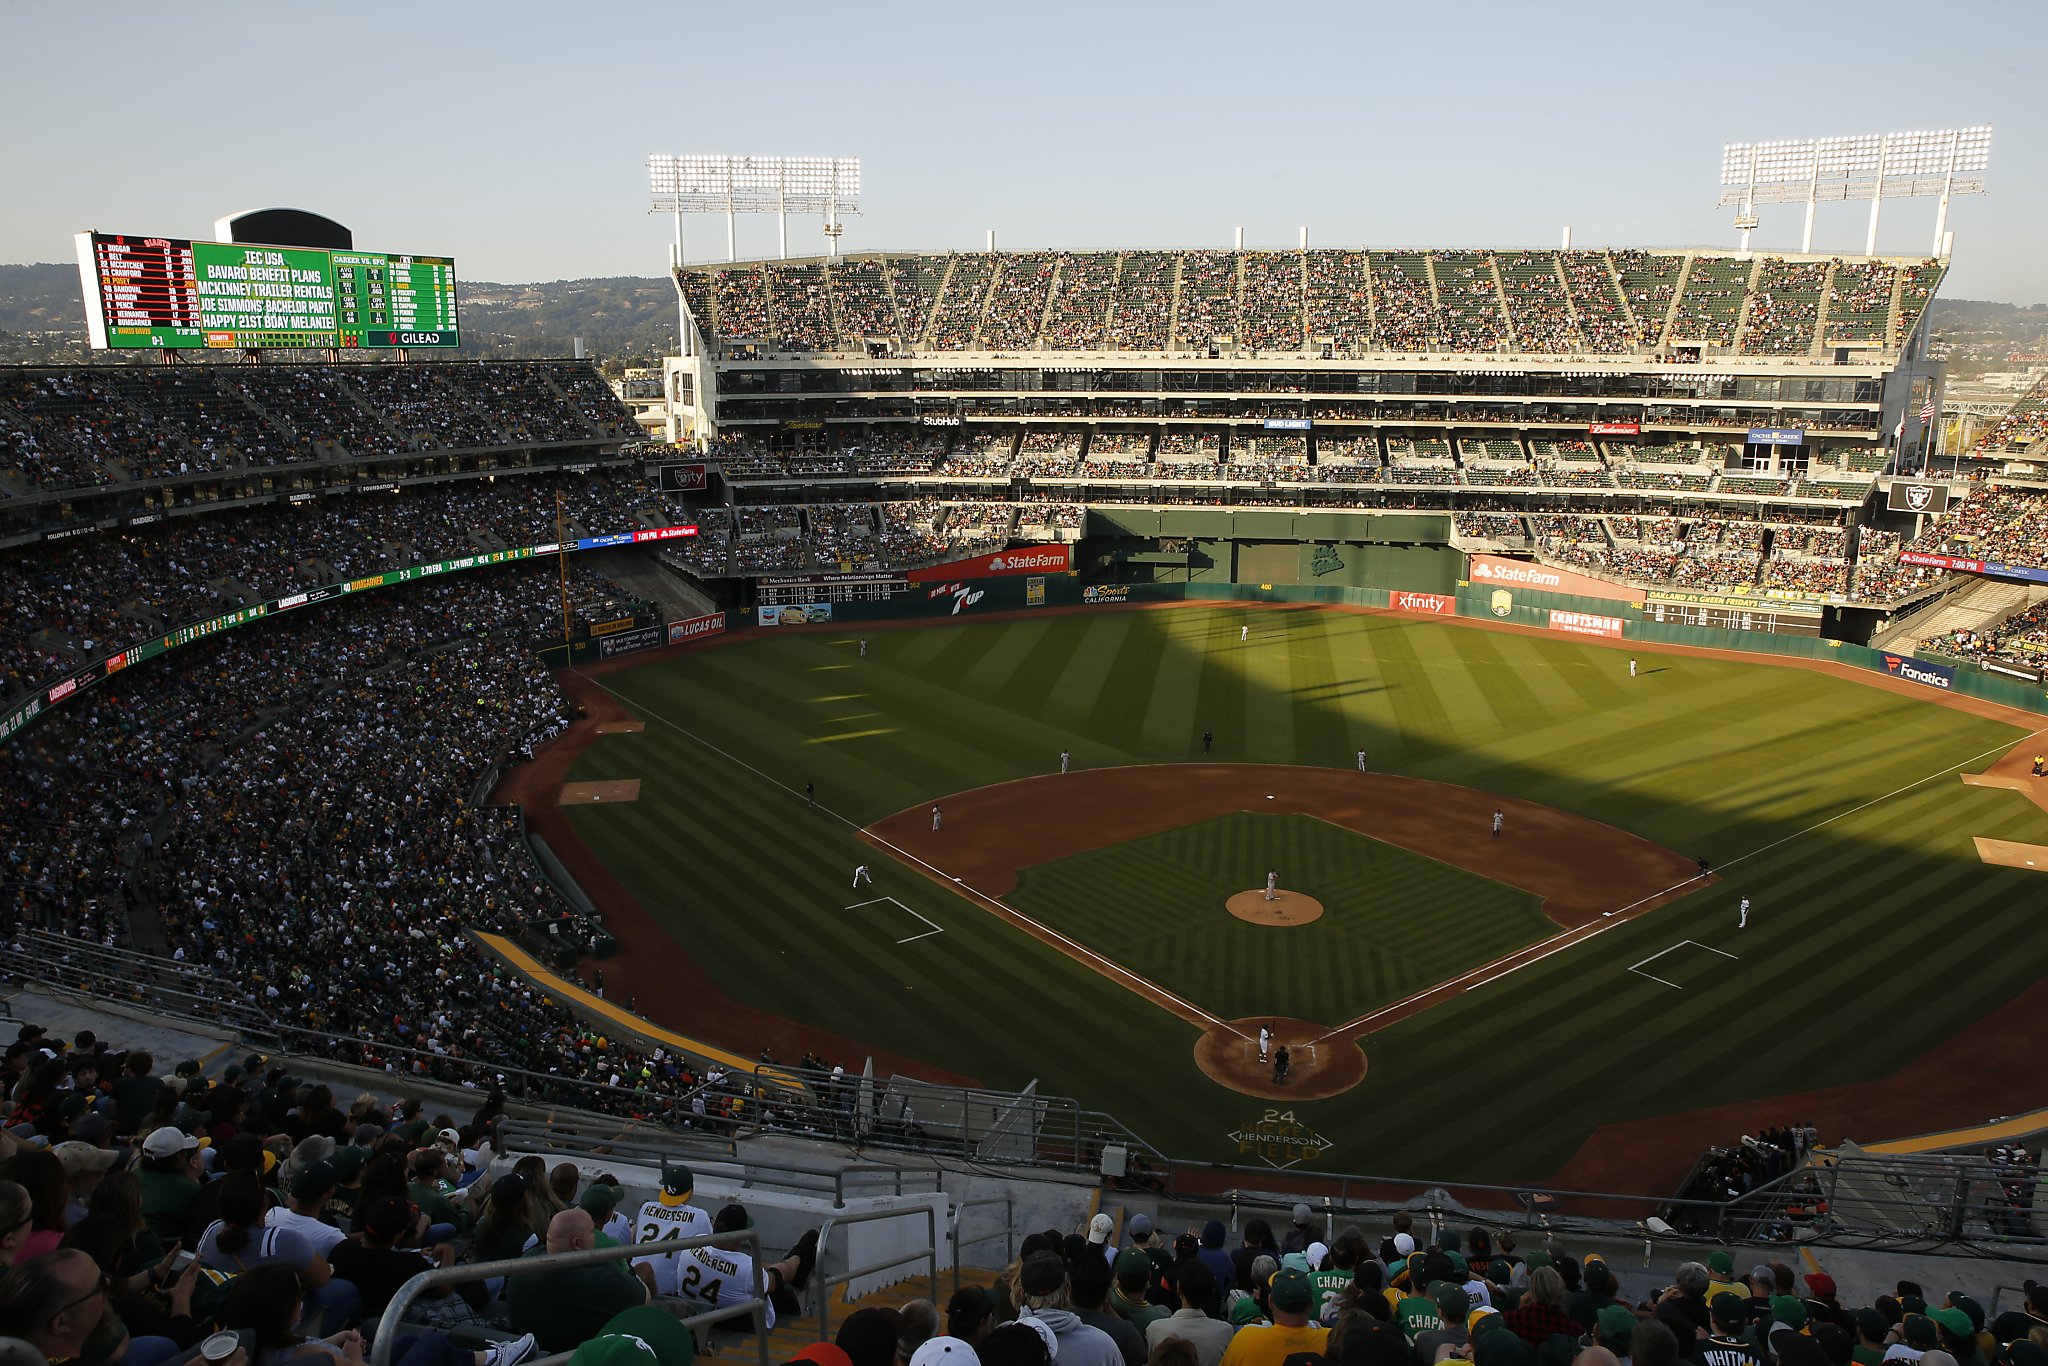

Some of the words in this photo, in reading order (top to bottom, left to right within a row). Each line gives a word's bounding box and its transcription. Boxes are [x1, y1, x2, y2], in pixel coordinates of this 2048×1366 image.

[107, 244, 131, 253] DUGGAR
[144, 238, 171, 248] GIANTS
[110, 261, 144, 269] MCCUTCHEN
[244, 250, 263, 265] IEC
[264, 251, 284, 266] USA
[334, 256, 360, 264] CAREER
[111, 269, 142, 277] CRAWFORD
[207, 265, 247, 280] BAVARO
[249, 267, 290, 282] BENEFIT
[291, 270, 321, 283] PLANS
[112, 277, 130, 285] POSEY
[198, 280, 251, 296] MCKINNEY
[253, 283, 293, 298] TRAILER
[294, 285, 333, 299] RENTALS
[200, 297, 217, 312] JOE
[219, 298, 264, 313] SIMMONS'
[265, 300, 308, 314] BACHELOR
[308, 301, 334, 315] PARTY
[202, 314, 236, 329] HAPPY
[239, 315, 263, 329] 21ST
[264, 315, 289, 329] BDAY
[291, 316, 335, 329] MELANIE!
[401, 333, 440, 344] GILEAD
[923, 417, 960, 426] StubHub
[1591, 424, 1638, 435] Budweiser
[363, 483, 394, 492] FOUNDATION
[47, 532, 64, 540] FOLLOW
[649, 531, 658, 539] PM
[668, 528, 695, 537] StateFarm
[351, 576, 384, 590] BUMGARNER
[421, 566, 432, 576] 2.70
[432, 564, 443, 573] ERA
[529, 548, 533, 556] T
[1006, 554, 1065, 569] StateFarm
[1910, 554, 1946, 566] StateFarm
[1952, 560, 1966, 569] 7:06
[1966, 562, 1978, 571] PM
[1492, 565, 1560, 587] StateFarm
[1097, 585, 1131, 598] Sports
[1649, 591, 1687, 601] OAKLAND
[1700, 596, 1725, 605] GREEN
[1725, 598, 1759, 607] FRIDAYS
[278, 593, 308, 609] LAGUNITAS
[1084, 596, 1127, 604] CALIFORNIA
[1398, 593, 1445, 613] xfinity
[1630, 601, 1643, 609] 362
[228, 614, 236, 624] SFG
[249, 608, 257, 617] OAK
[1551, 612, 1620, 631] CRAFTSMAN
[200, 624, 205, 635] S
[684, 620, 709, 636] LUCAS
[711, 617, 723, 628] OIL
[641, 631, 660, 641] xfinity
[575, 642, 586, 650] 330
[1829, 640, 1842, 648] 367
[1900, 663, 1949, 688] Fanatics
[49, 678, 76, 702] LAGUNITAS
[1264, 1109, 1296, 1123] 24
[1242, 1121, 1317, 1137] RICKEY
[1239, 1133, 1321, 1146] HENDERSON
[1239, 1141, 1321, 1160] FIELD
[643, 1205, 696, 1224] HENDERSON
[640, 1223, 681, 1259] 24
[690, 1247, 738, 1277] HENDERSON
[682, 1265, 723, 1305] 24
